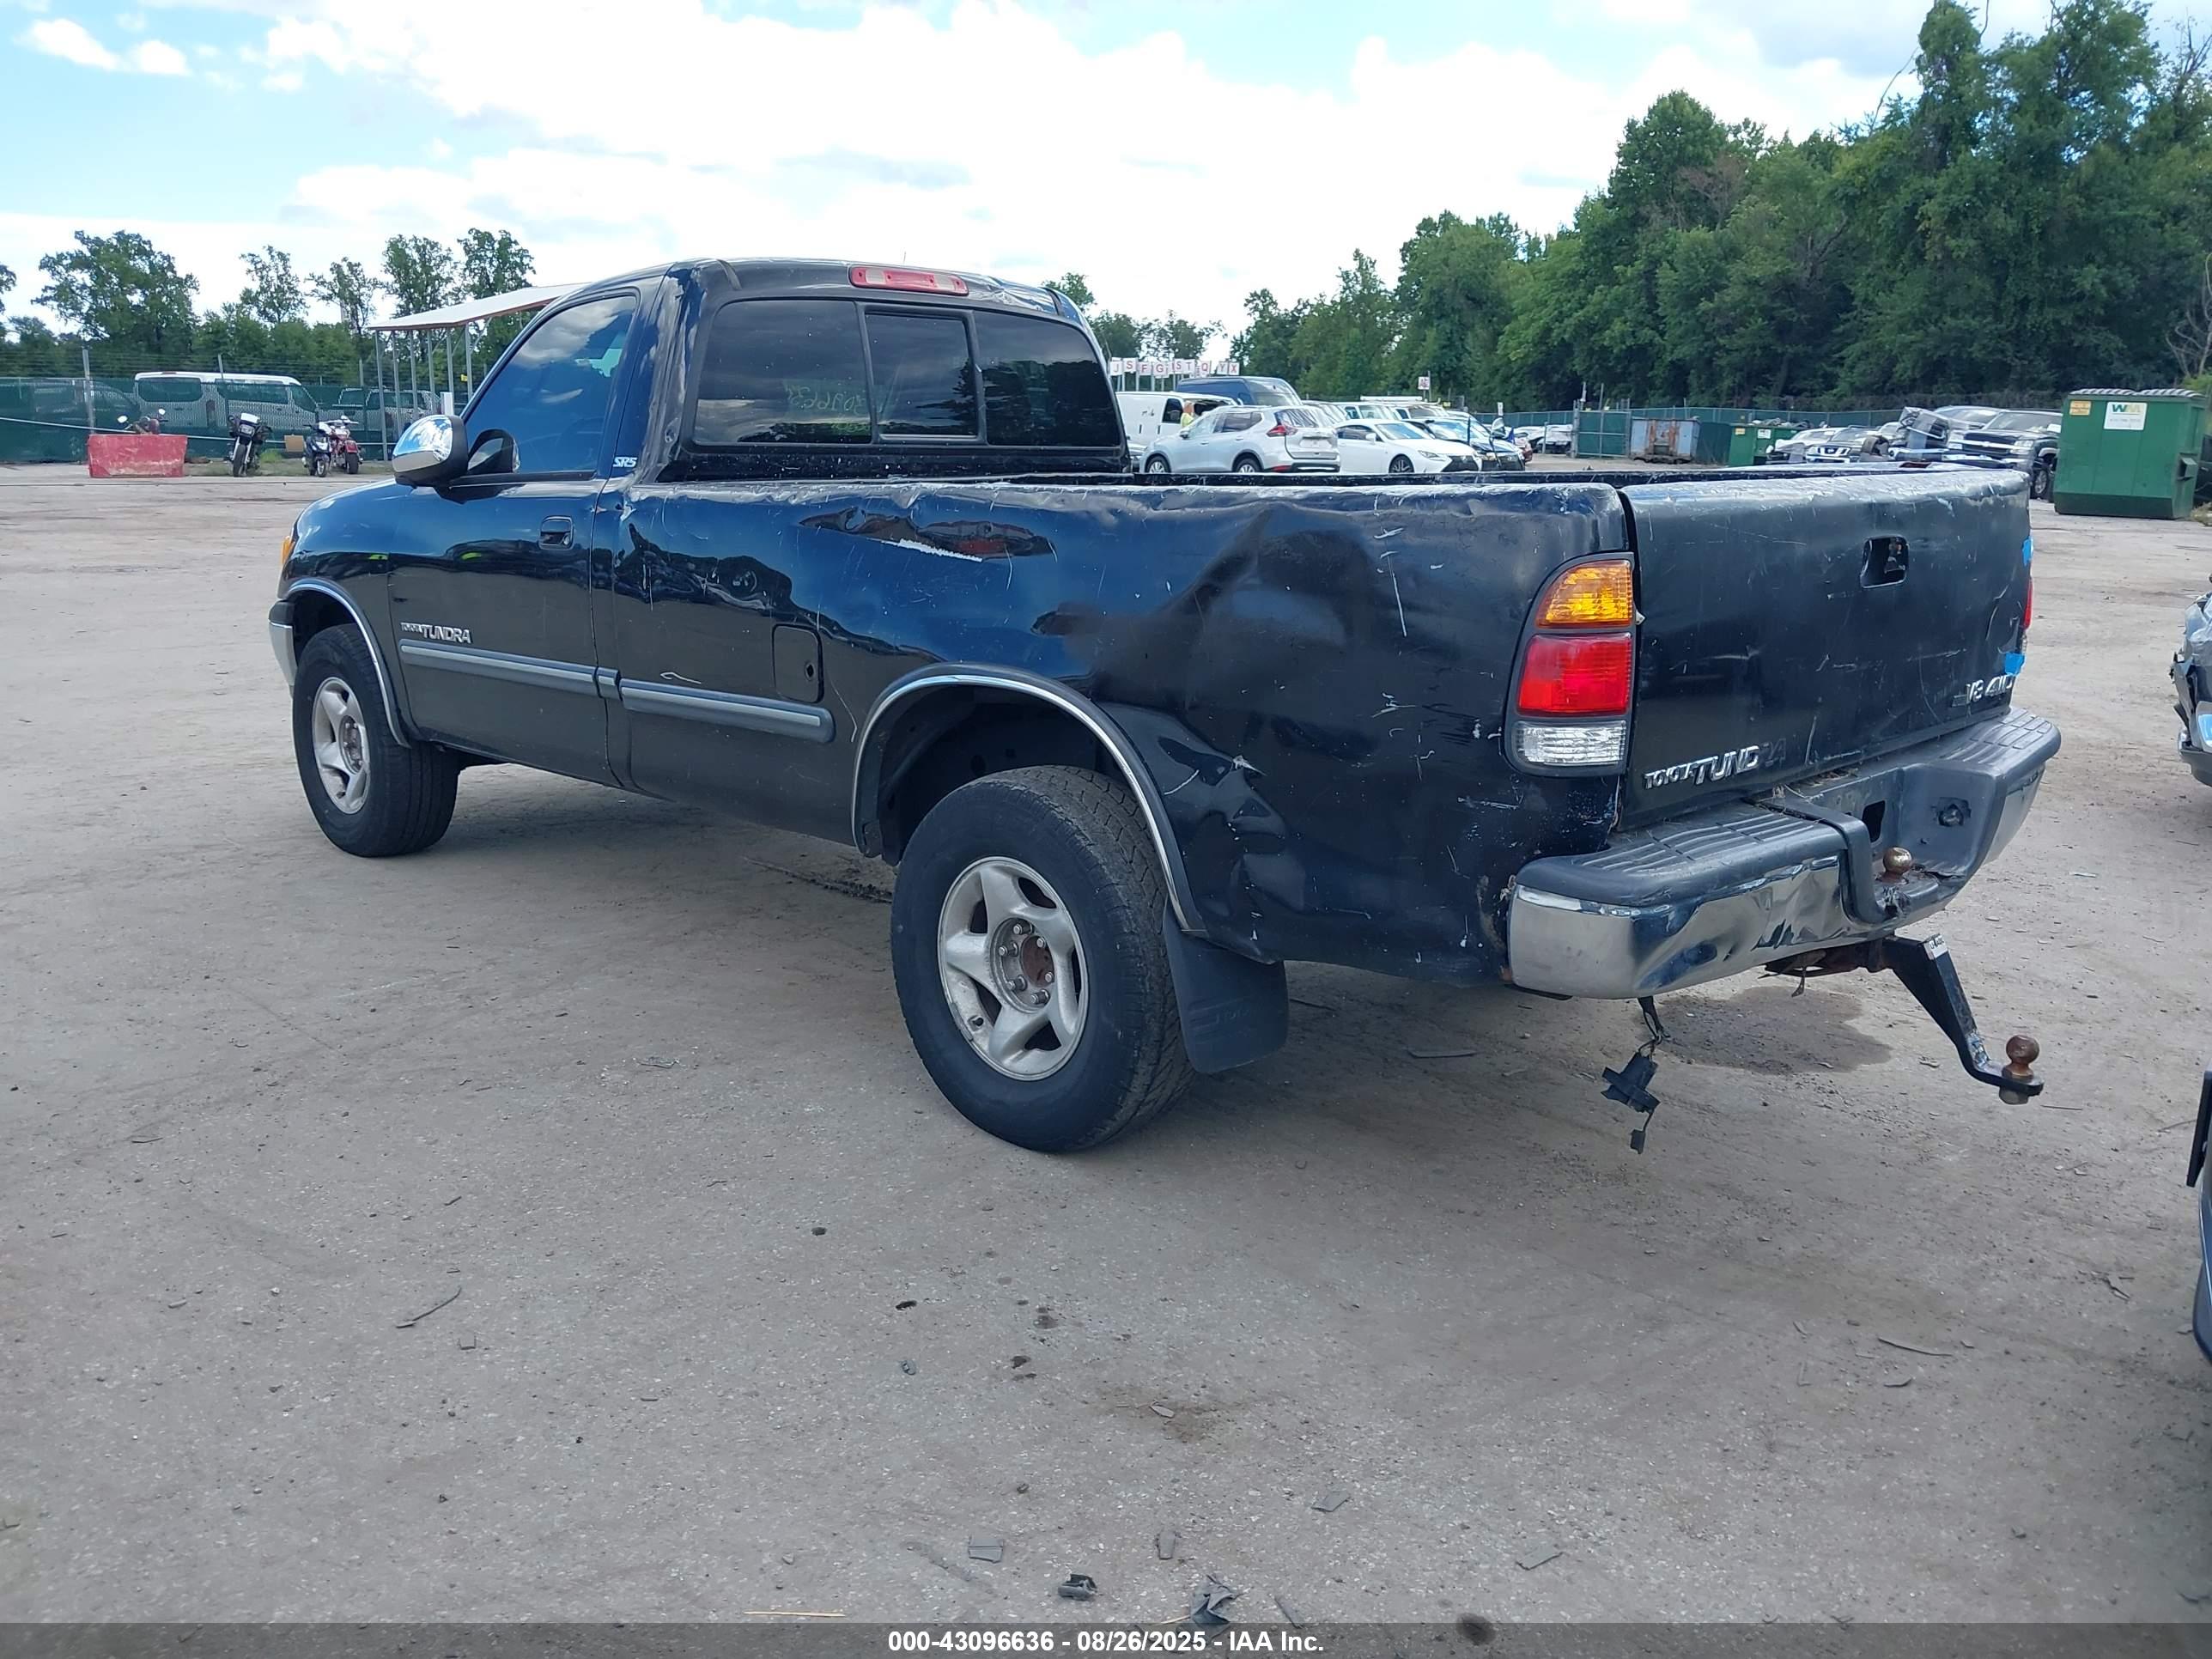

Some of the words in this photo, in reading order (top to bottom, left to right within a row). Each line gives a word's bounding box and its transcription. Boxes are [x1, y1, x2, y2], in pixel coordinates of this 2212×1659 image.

[1126, 361, 1133, 370] S
[1141, 364, 1148, 373] F
[1156, 363, 1164, 373] G
[1176, 361, 1182, 370] S
[1185, 362, 1193, 370] T
[1219, 363, 1225, 372] Y
[1231, 364, 1237, 373] X
[2112, 404, 2144, 413] WM
[612, 456, 638, 468] SR5
[421, 624, 471, 643] TUNDRA
